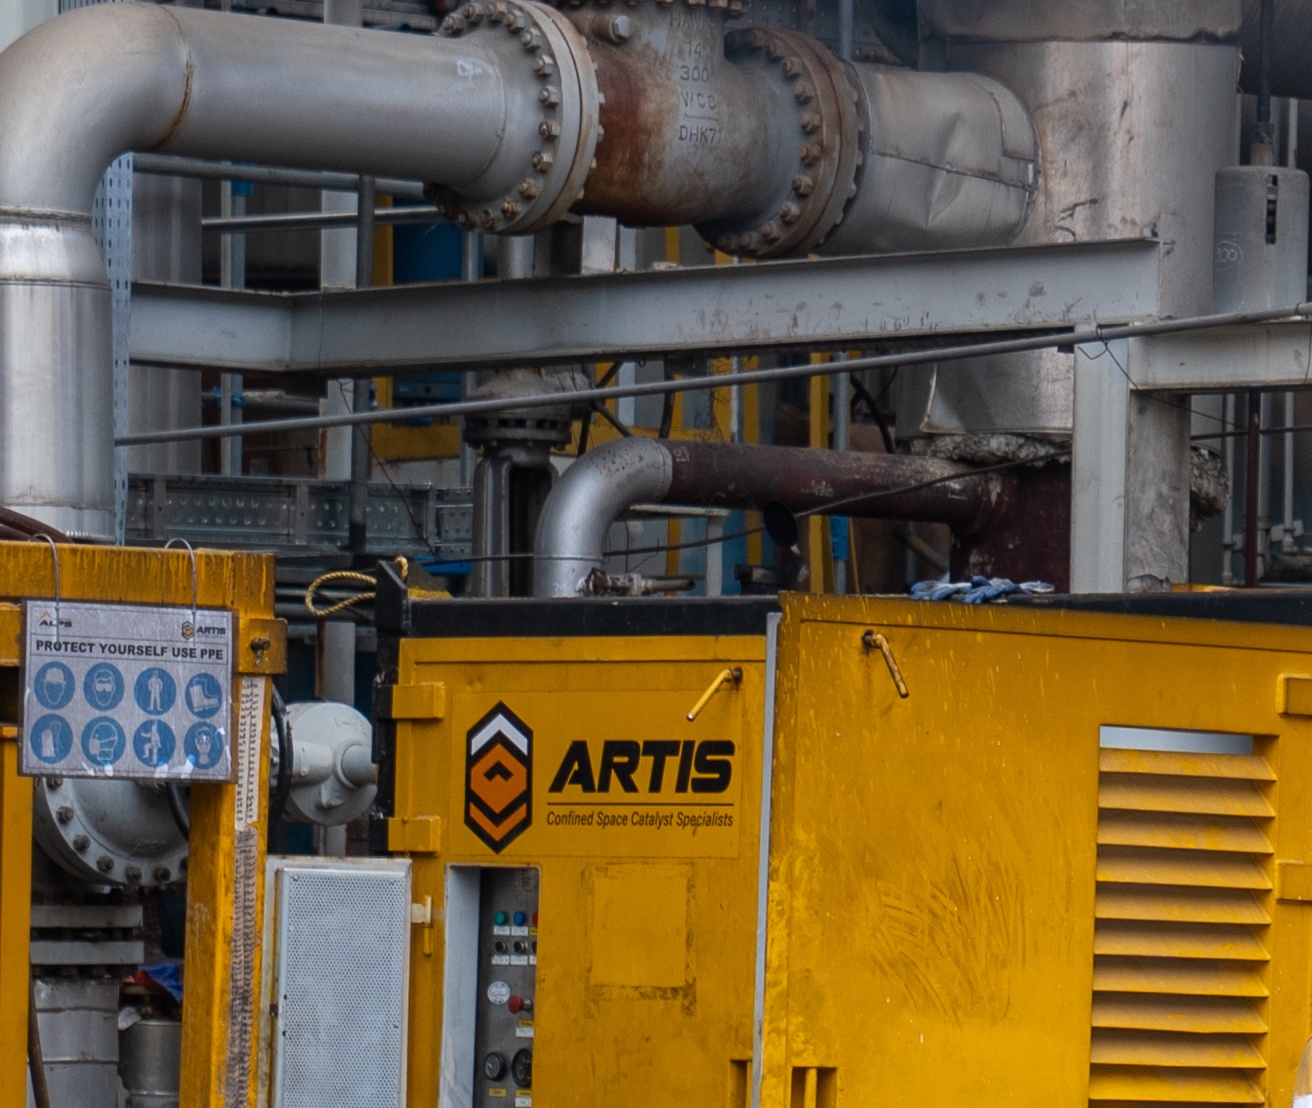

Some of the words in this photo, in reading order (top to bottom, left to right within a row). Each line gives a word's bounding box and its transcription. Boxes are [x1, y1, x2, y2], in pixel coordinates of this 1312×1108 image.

[679, 65, 709, 82] 300
[196, 626, 226, 636] ARTIS
[35, 639, 96, 654] PROTECT
[99, 643, 168, 658] YOURSELF
[171, 646, 197, 659] USE
[200, 648, 224, 661] PPE
[548, 740, 735, 793] ARTIS
[547, 811, 594, 826] Confined
[596, 811, 628, 829] Space
[631, 811, 673, 830] Catalyst
[676, 811, 734, 829] Specialists
